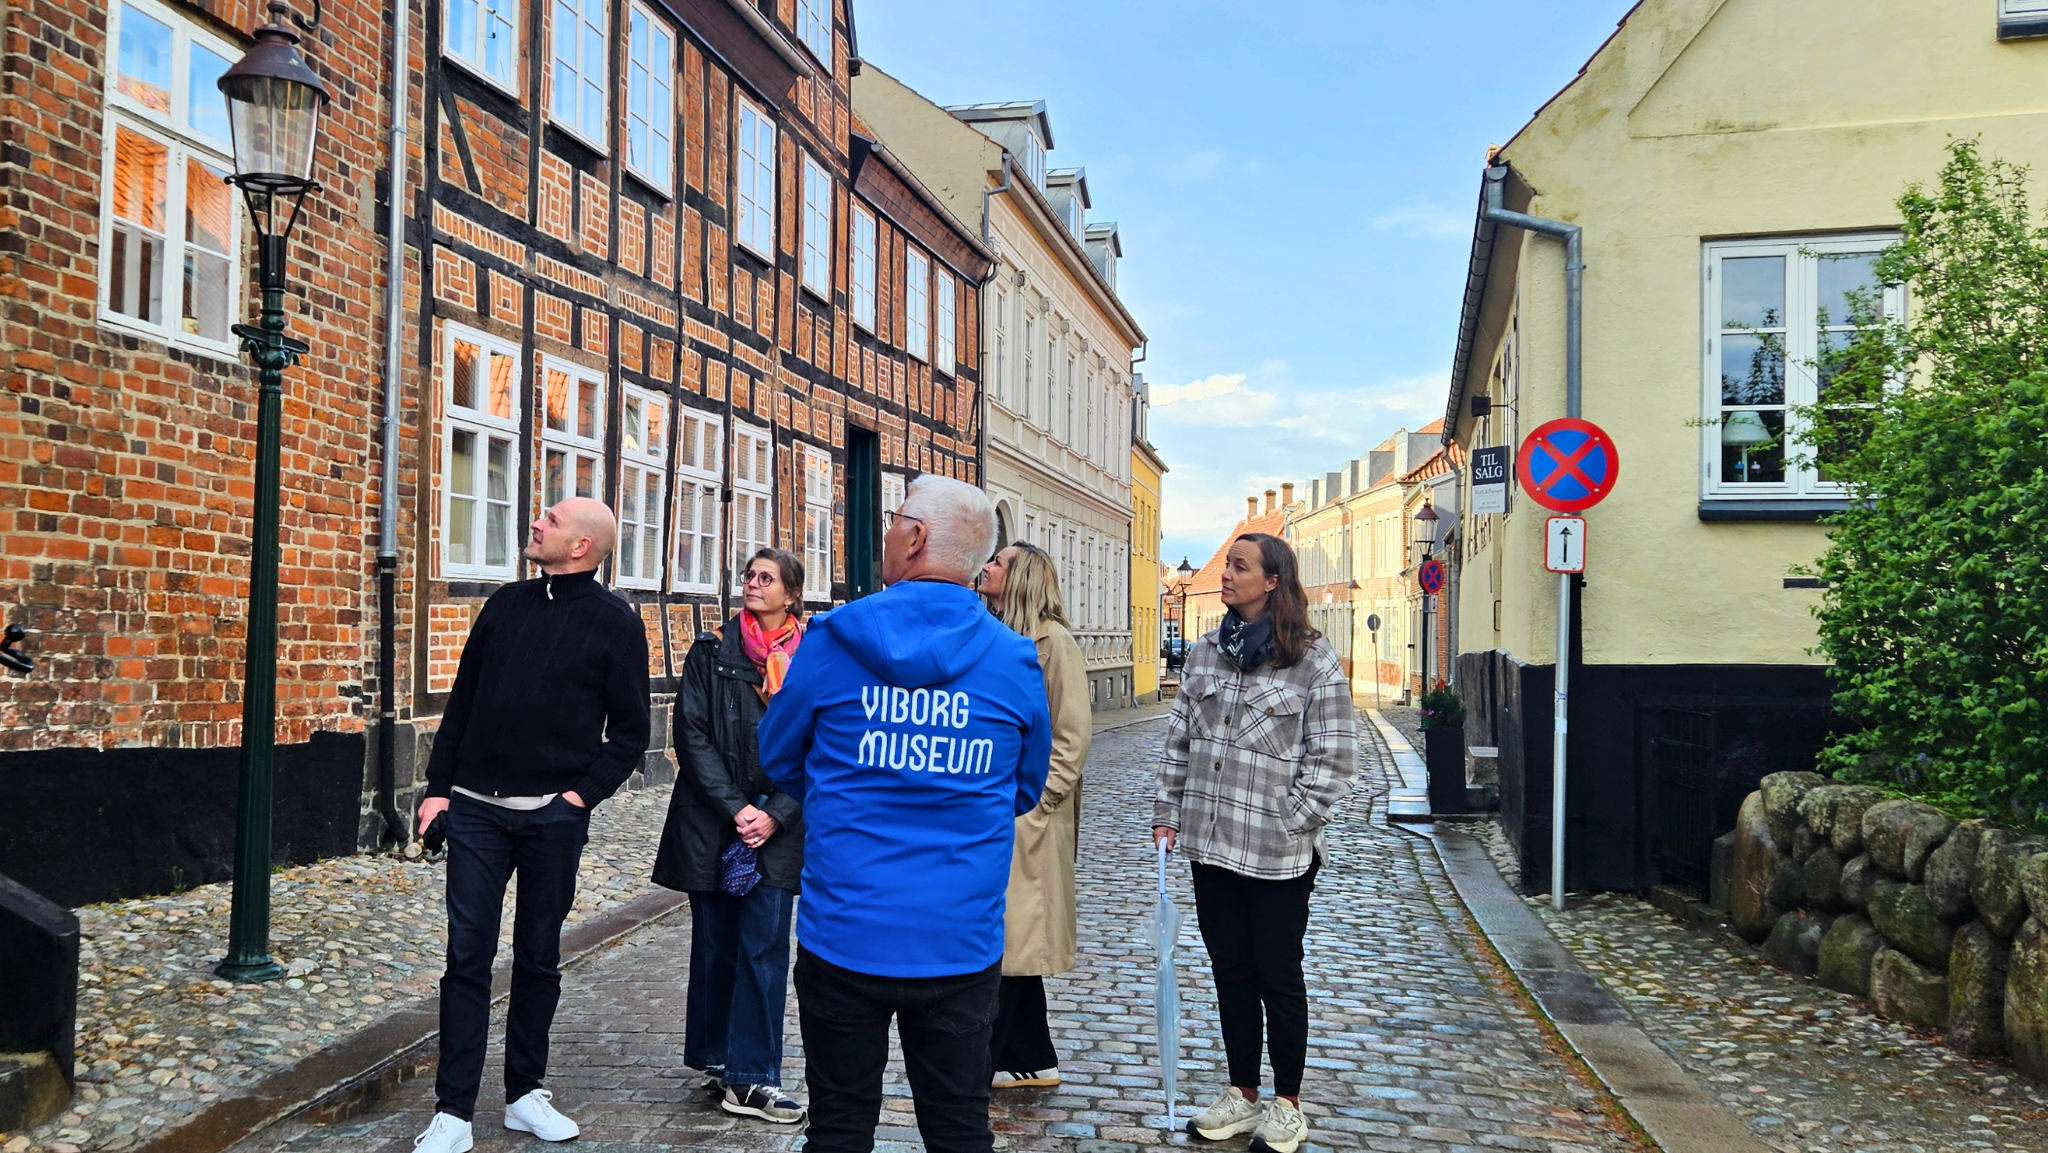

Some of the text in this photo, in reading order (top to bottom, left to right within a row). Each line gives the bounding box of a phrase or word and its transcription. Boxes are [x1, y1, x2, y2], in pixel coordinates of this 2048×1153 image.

[1475, 465, 1503, 479] SALG
[1480, 453, 1498, 466] TIL
[861, 686, 969, 729] VIBORG
[858, 729, 994, 774] MUSEUM
